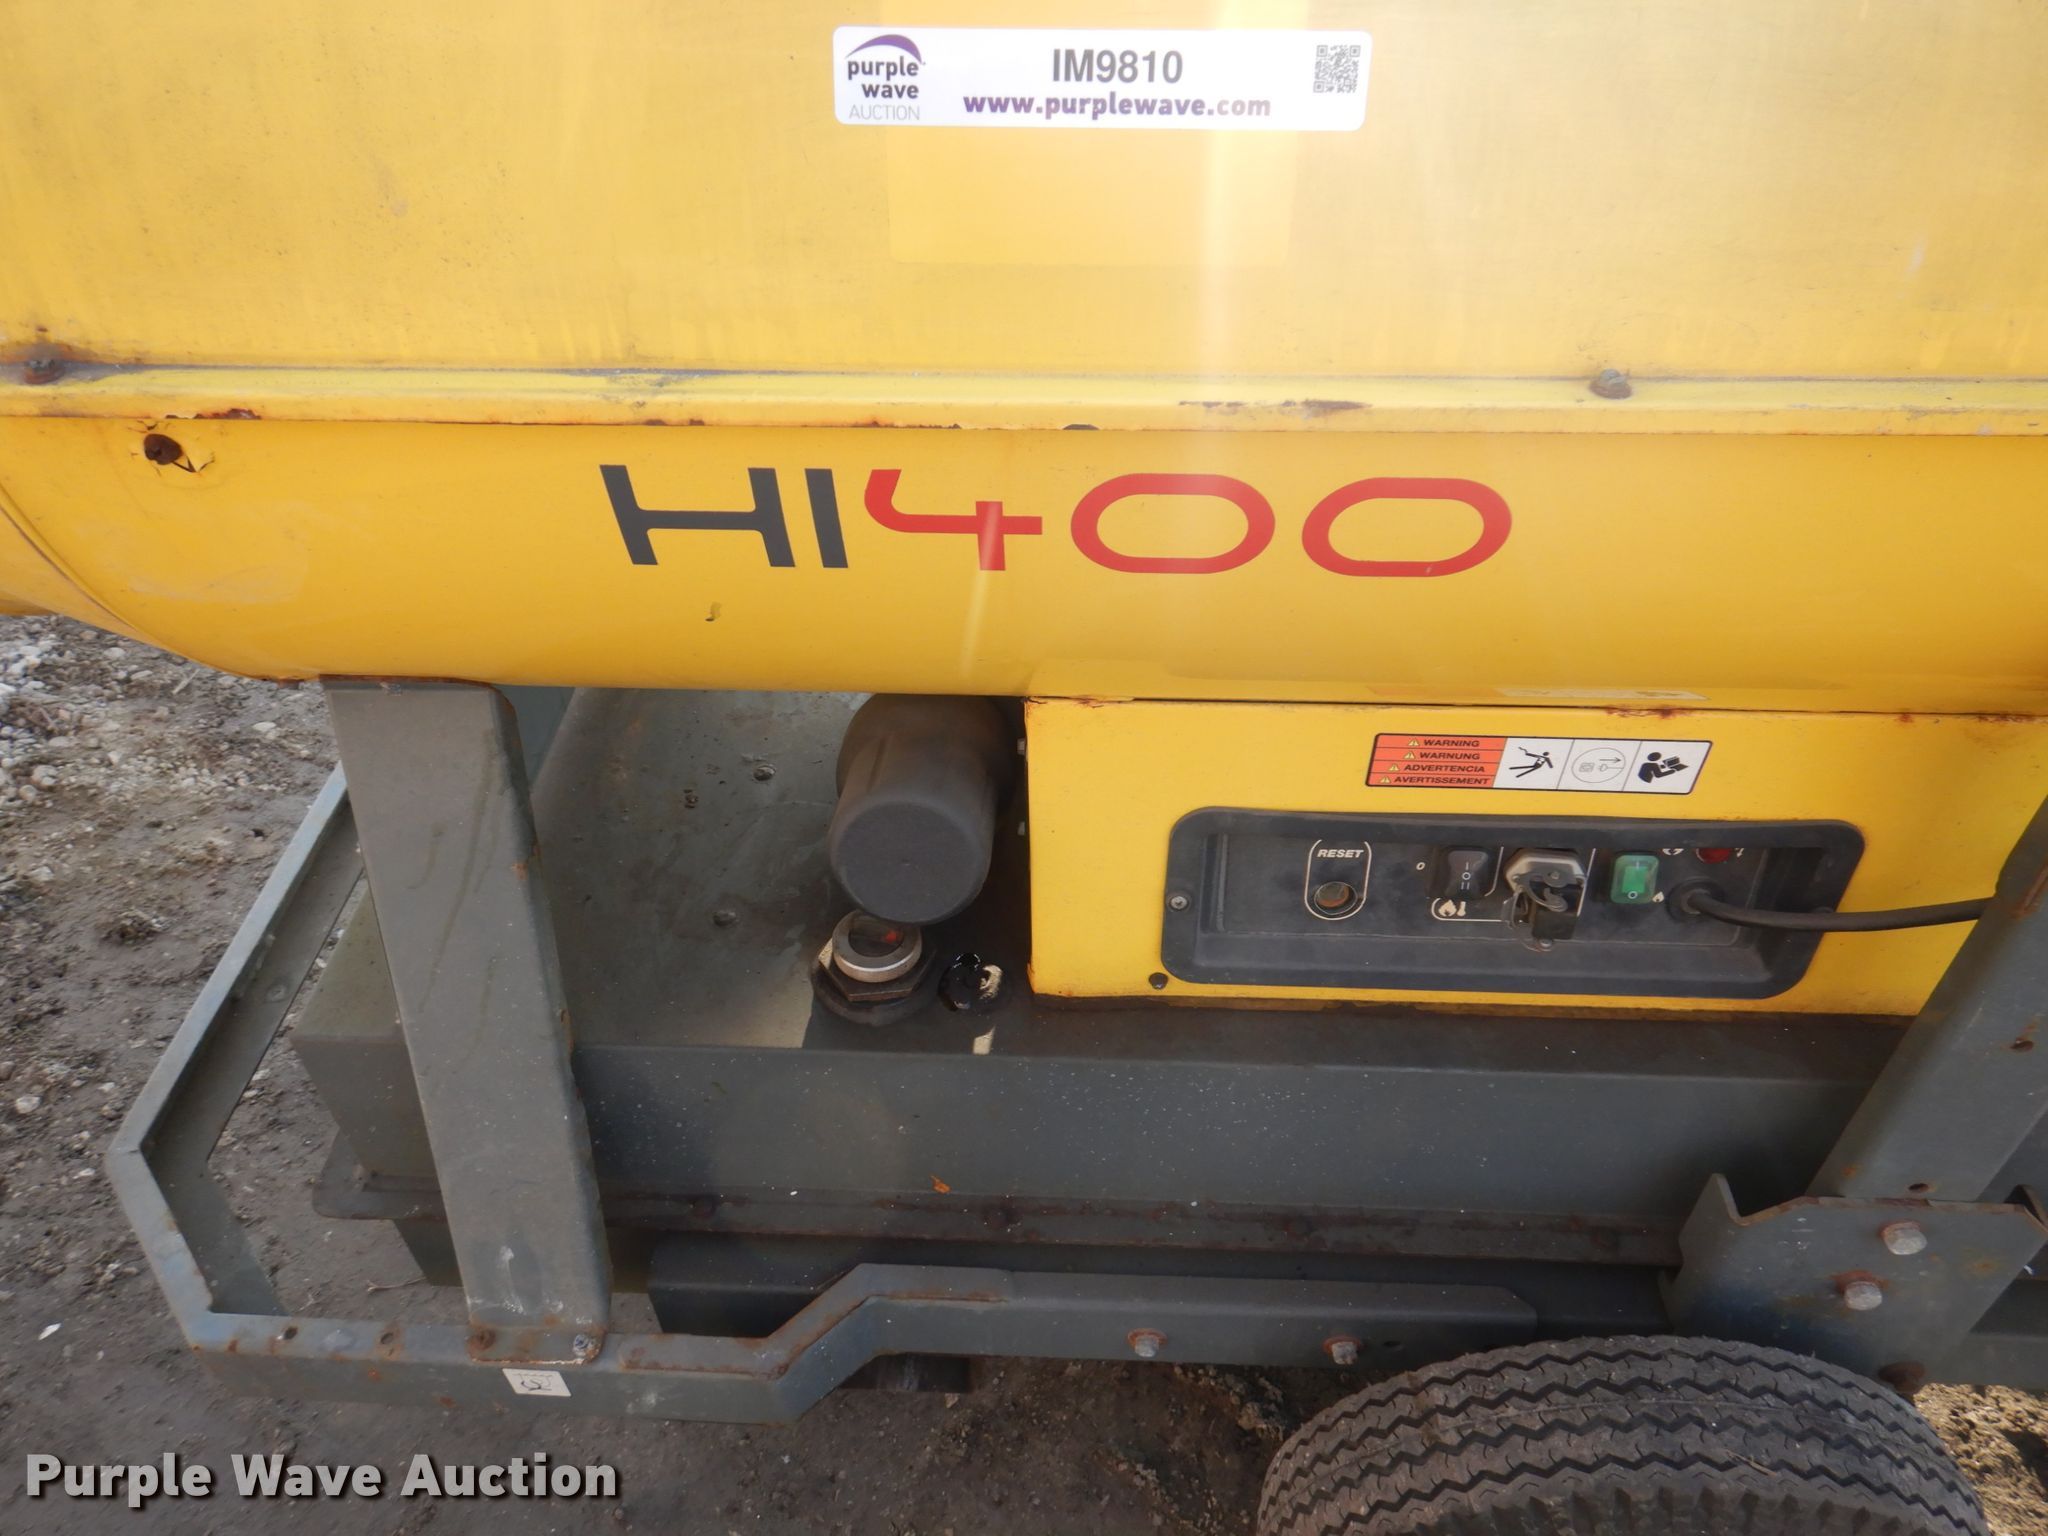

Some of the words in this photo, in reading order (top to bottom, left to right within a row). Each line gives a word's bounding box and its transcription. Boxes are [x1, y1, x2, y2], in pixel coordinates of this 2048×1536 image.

[847, 55, 919, 80] purple
[1053, 48, 1183, 83] IM9810
[861, 83, 919, 99] wave
[848, 103, 920, 121] AUCTION
[963, 91, 1272, 120] www.purplewave.com
[1423, 739, 1480, 748] WARNING
[1419, 751, 1480, 760] WARNUNG
[1403, 764, 1485, 773] ADVERTENCIA
[1393, 776, 1489, 785] AVERTISSEMENT
[1317, 848, 1365, 859] RESET
